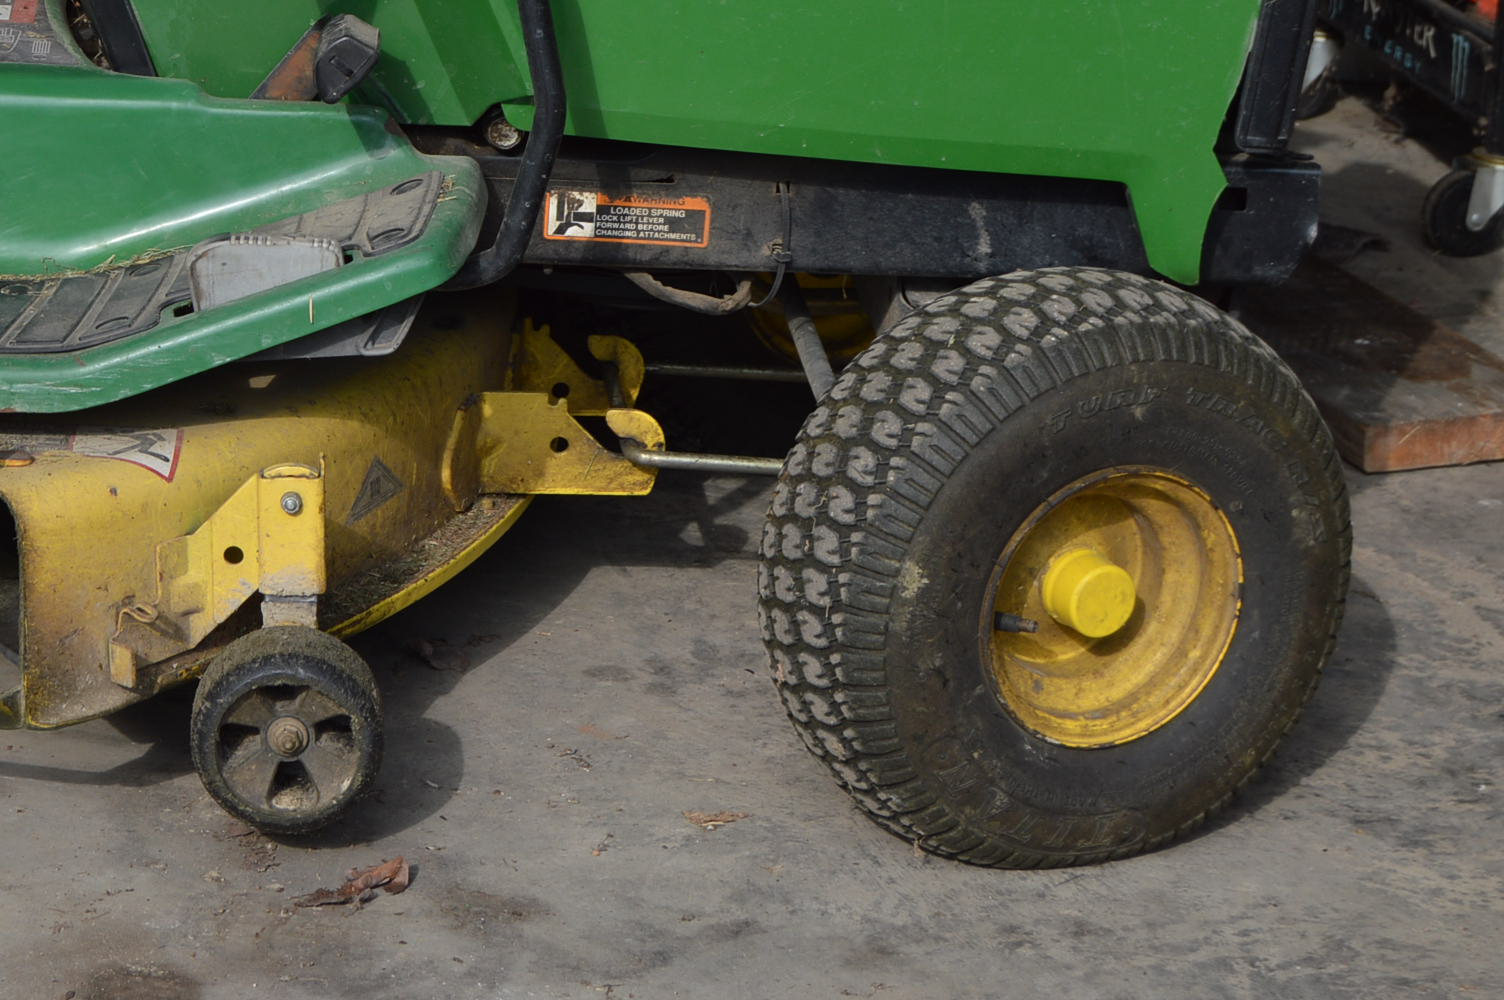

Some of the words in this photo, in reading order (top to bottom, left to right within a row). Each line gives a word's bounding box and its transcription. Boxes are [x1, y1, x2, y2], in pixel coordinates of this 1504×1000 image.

[610, 206, 649, 217] LOADED
[650, 208, 686, 218] SPRING
[596, 214, 618, 222] LOCK
[620, 215, 637, 223] LIFT
[638, 216, 665, 224] LEVER
[596, 222, 636, 230] FORWARD
[637, 223, 670, 232] BEFORE
[595, 229, 637, 238] CHANGING
[638, 231, 697, 241] ATTACHMENTS
